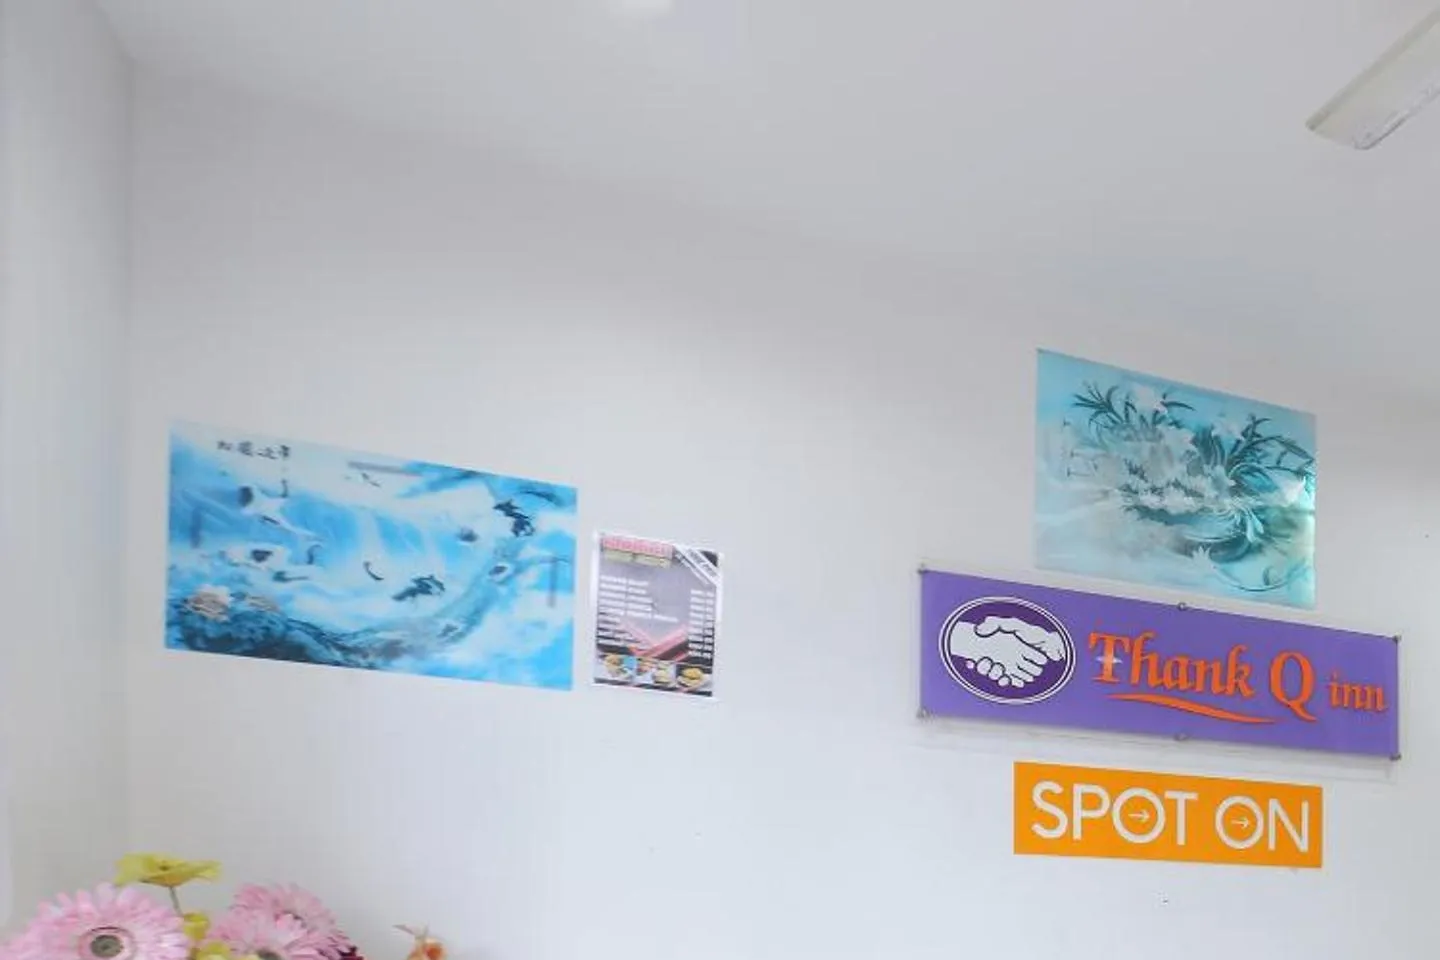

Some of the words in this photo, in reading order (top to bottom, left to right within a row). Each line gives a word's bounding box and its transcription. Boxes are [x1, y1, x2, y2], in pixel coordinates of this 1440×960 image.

[1088, 628, 1257, 699] Thank
[1269, 650, 1319, 723] Q
[1328, 669, 1388, 712] inn
[1030, 779, 1199, 846] SPOT
[1214, 795, 1309, 853] ON
